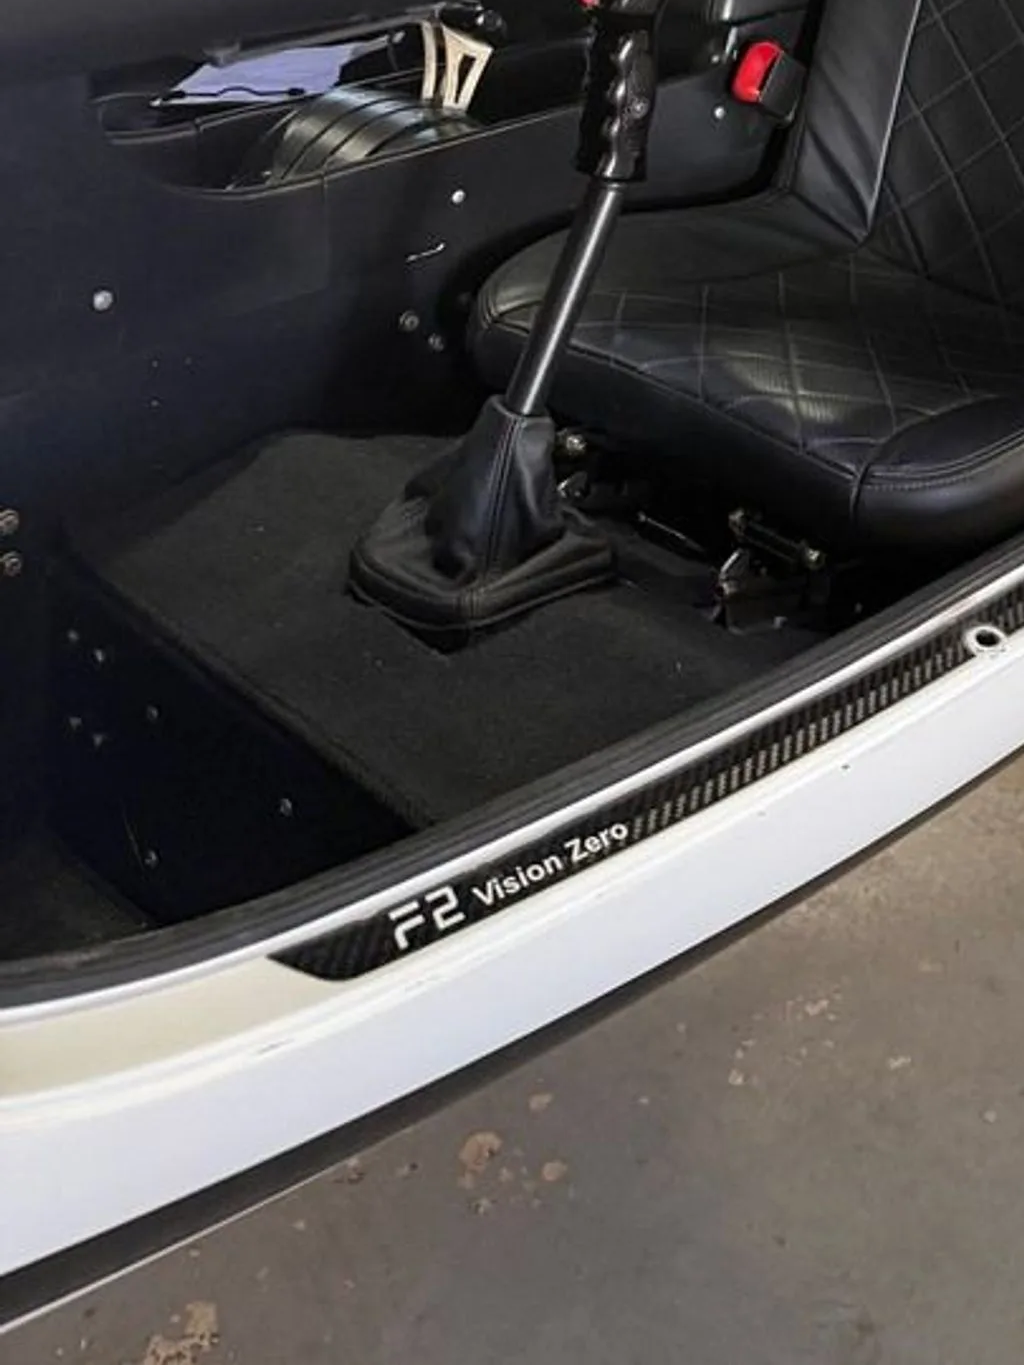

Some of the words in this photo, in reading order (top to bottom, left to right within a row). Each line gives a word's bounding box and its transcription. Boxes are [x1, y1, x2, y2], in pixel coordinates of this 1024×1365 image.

[388, 885, 466, 950] F2
[472, 853, 564, 907] Vision
[564, 821, 629, 864] Zero
